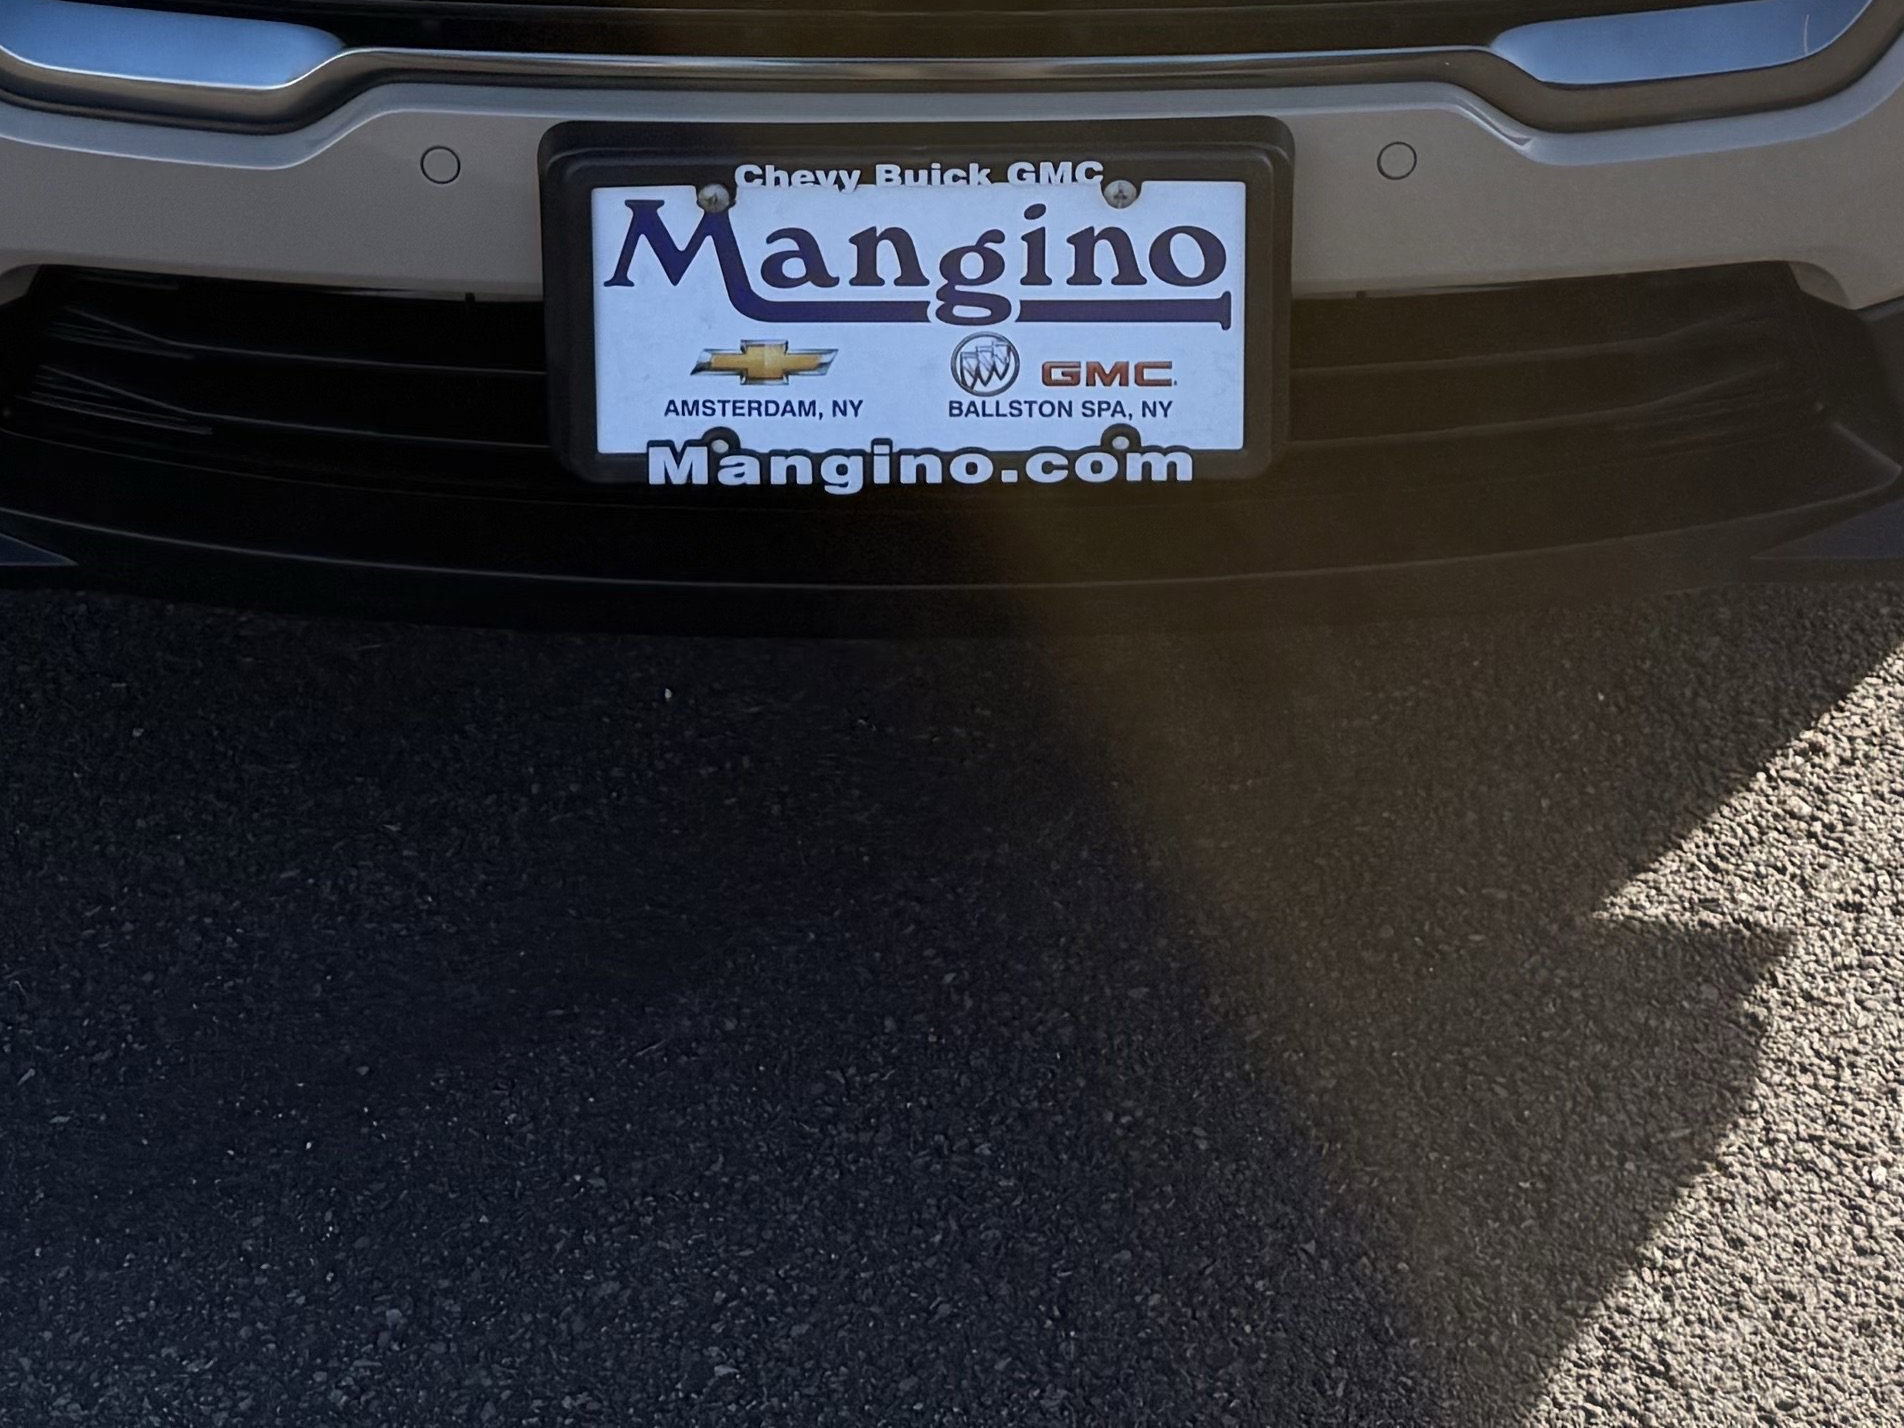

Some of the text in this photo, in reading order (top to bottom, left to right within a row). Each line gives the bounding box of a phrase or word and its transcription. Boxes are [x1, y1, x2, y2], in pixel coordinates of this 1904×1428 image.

[733, 160, 1104, 192] Chevy Buick GMC
[603, 199, 1231, 330] Mangino
[1041, 360, 1177, 388] GMC
[663, 399, 864, 421] AMSTERDAM, NY
[948, 399, 1173, 421] BALLSTON SPA, NY
[647, 442, 1193, 495] Mangino.com
